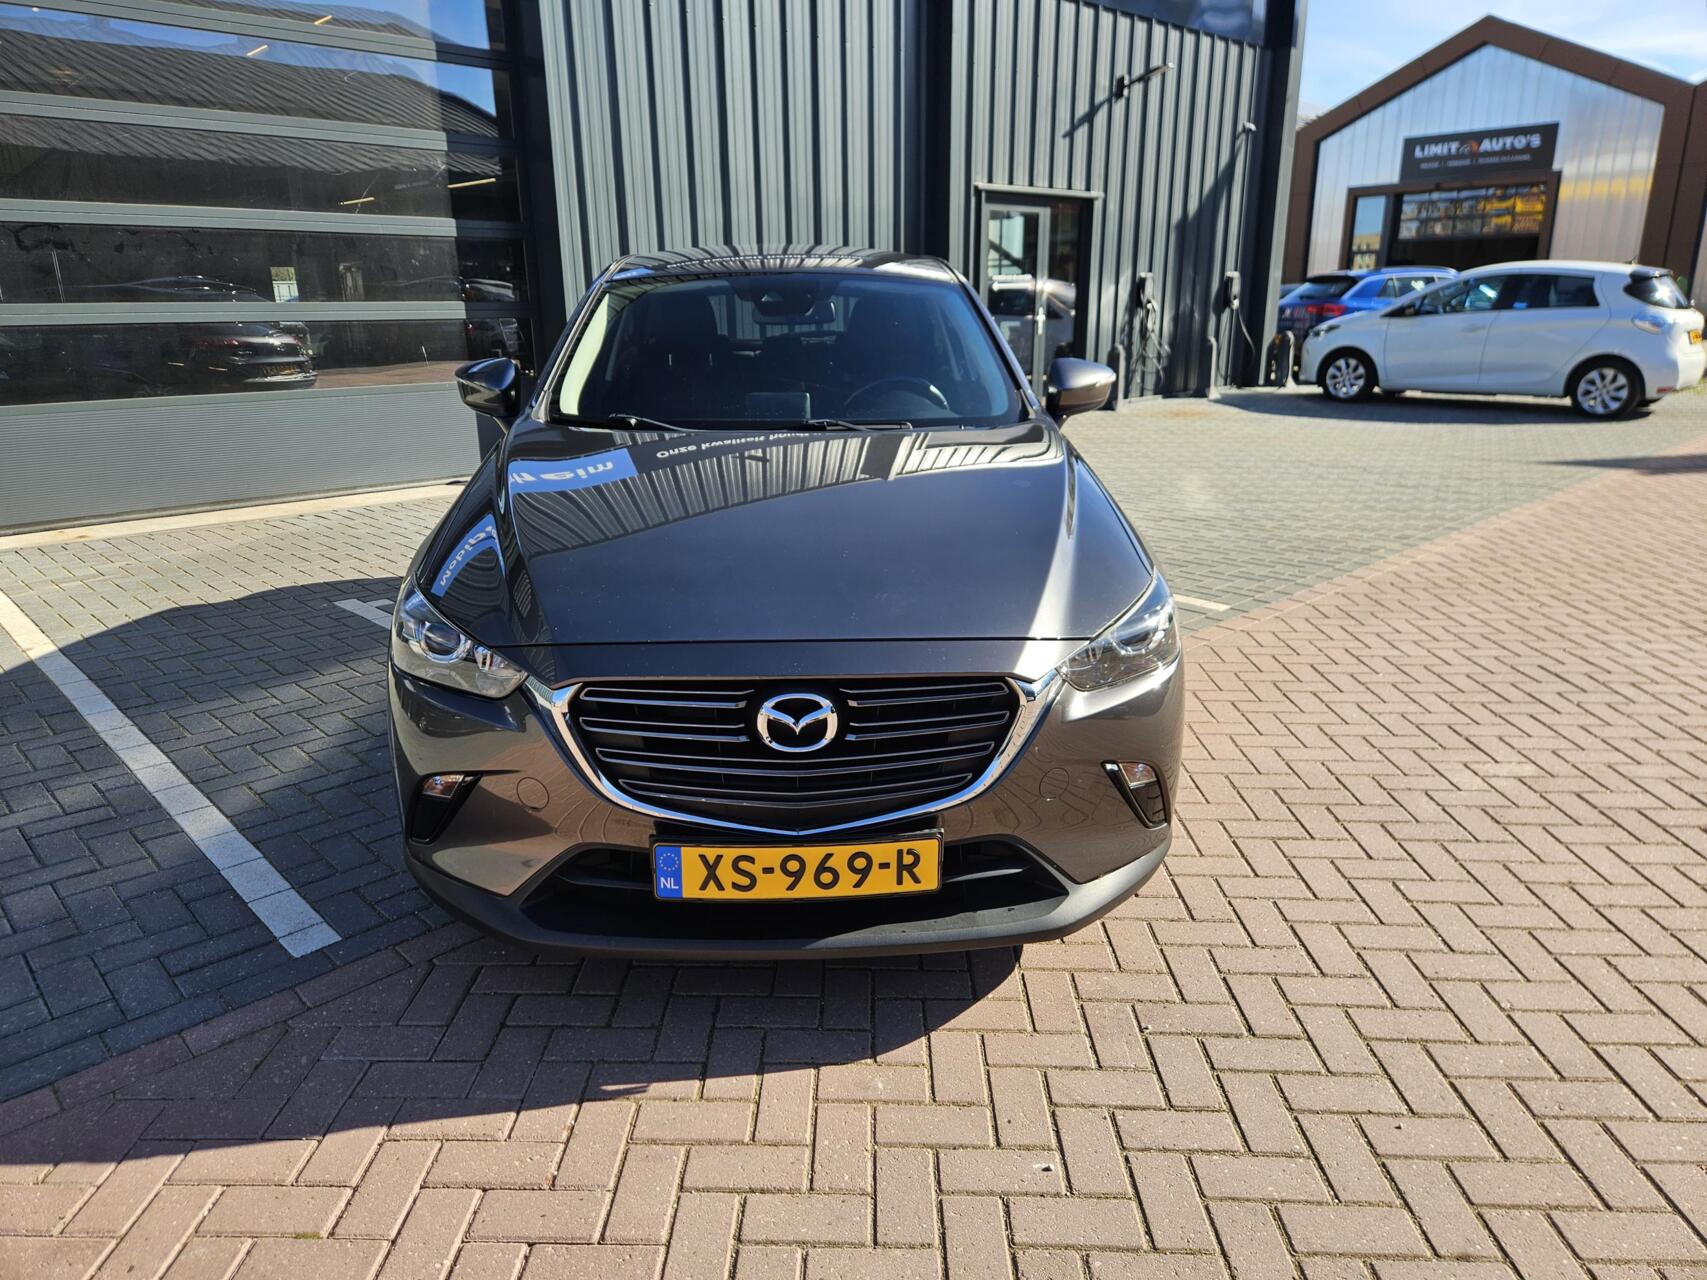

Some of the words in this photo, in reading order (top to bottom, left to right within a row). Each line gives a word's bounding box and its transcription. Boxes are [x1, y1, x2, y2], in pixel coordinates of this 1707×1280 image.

[1414, 141, 1459, 158] LIMIT
[1479, 133, 1541, 152] AUTO'S
[660, 877, 679, 889] NL
[698, 848, 922, 893] XS-969-R
